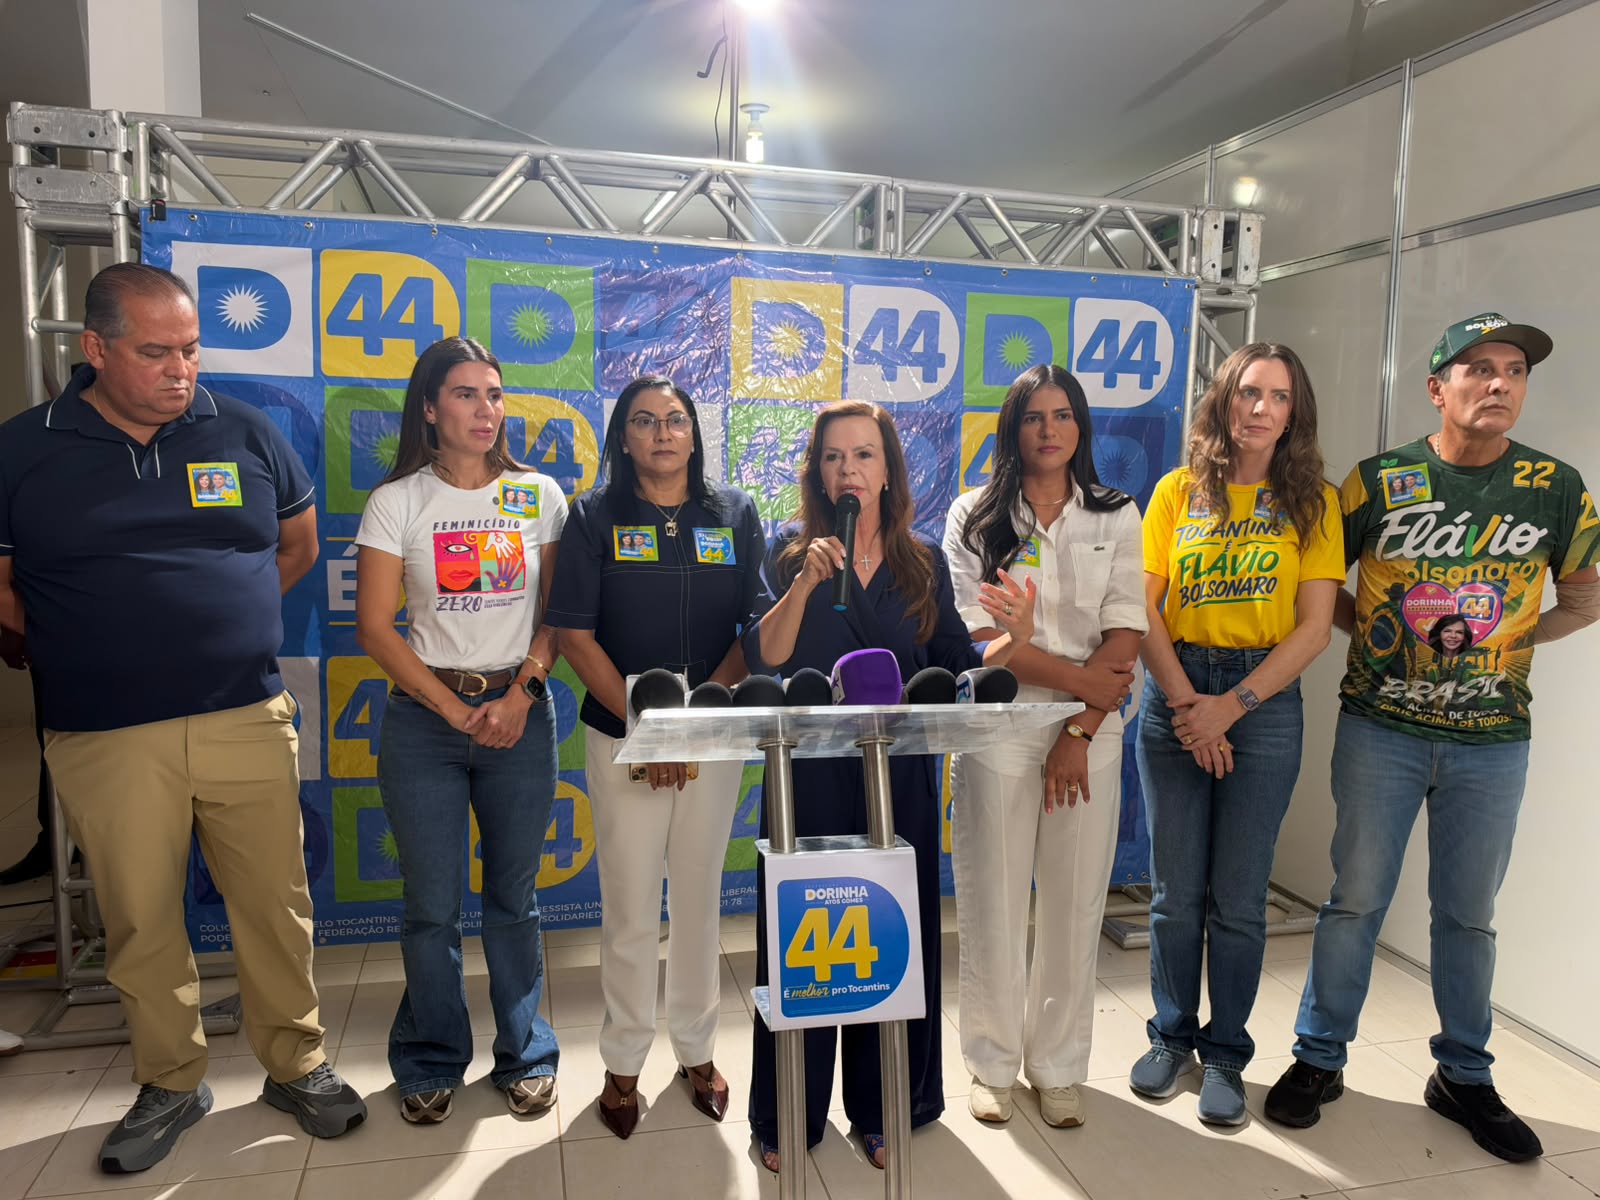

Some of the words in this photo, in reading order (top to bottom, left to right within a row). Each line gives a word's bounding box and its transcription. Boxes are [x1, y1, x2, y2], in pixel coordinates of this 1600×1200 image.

[326, 272, 445, 356] 44
[853, 307, 946, 383] 44
[1076, 318, 1161, 390] 44
[1513, 461, 1556, 489] 22
[433, 518, 521, 531] FEMINICÍDIO
[1176, 517, 1283, 549] TOCANTINS
[1375, 501, 1548, 562] Flávio
[703, 547, 724, 560] 44
[1178, 546, 1280, 585] FLÁVIO
[327, 543, 360, 611] É
[1403, 559, 1537, 586] olsonaro
[436, 595, 483, 614] ZERO
[1179, 576, 1277, 609] BOLSONARO
[1406, 598, 1453, 606] DORINHA
[1461, 597, 1492, 618] 44
[1377, 670, 1506, 706] BRASIL
[334, 679, 388, 757] 4
[1415, 712, 1455, 726] ACIMA
[721, 886, 758, 897] LIBERAL
[804, 885, 869, 901] DORINHA
[841, 897, 864, 905] GOMES
[200, 933, 232, 943] PODE
[318, 925, 384, 938] FEDERAÇÃO
[785, 905, 879, 982] 44
[784, 987, 790, 998] É
[791, 982, 830, 998] melhor
[831, 985, 847, 997] pro
[848, 982, 891, 993] Tocantins
